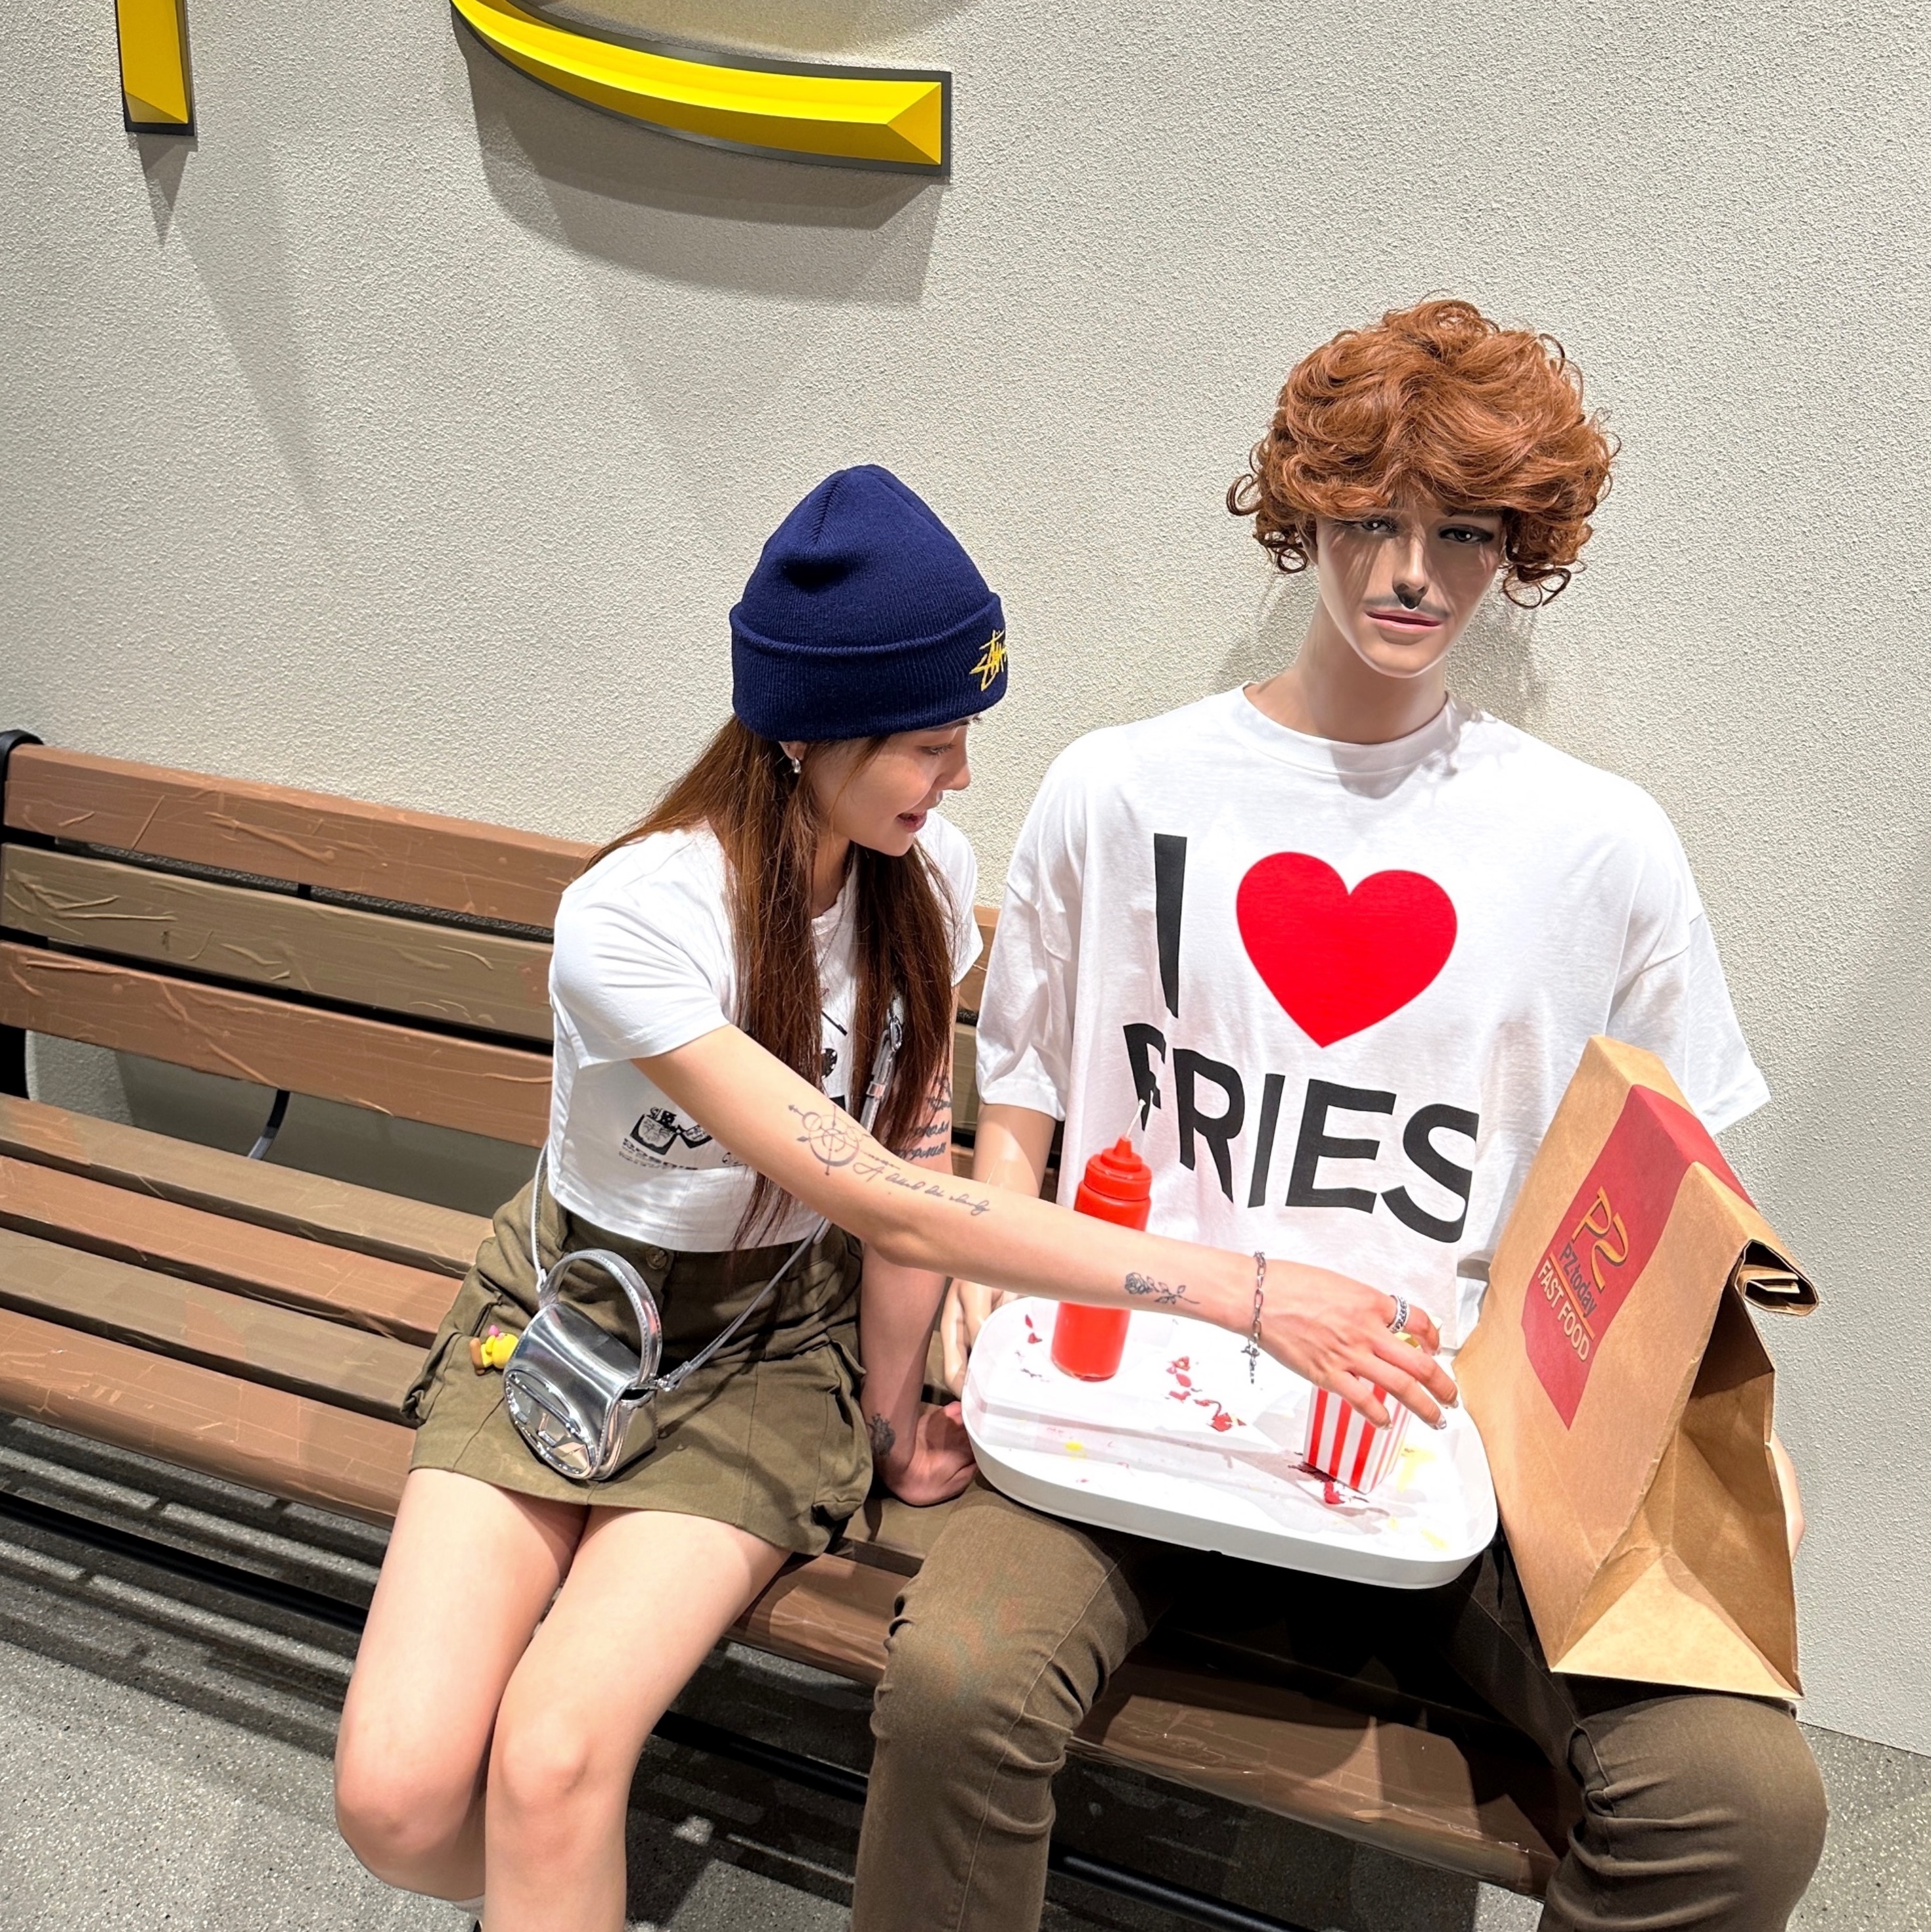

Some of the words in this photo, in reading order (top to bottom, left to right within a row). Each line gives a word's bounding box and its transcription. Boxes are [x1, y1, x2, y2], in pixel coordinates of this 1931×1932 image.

[1154, 832, 1187, 1019] I
[1123, 1022, 1480, 1244] FRIES
[1537, 1259, 1564, 1308] FAST
[1557, 1302, 1590, 1362] FOOD
